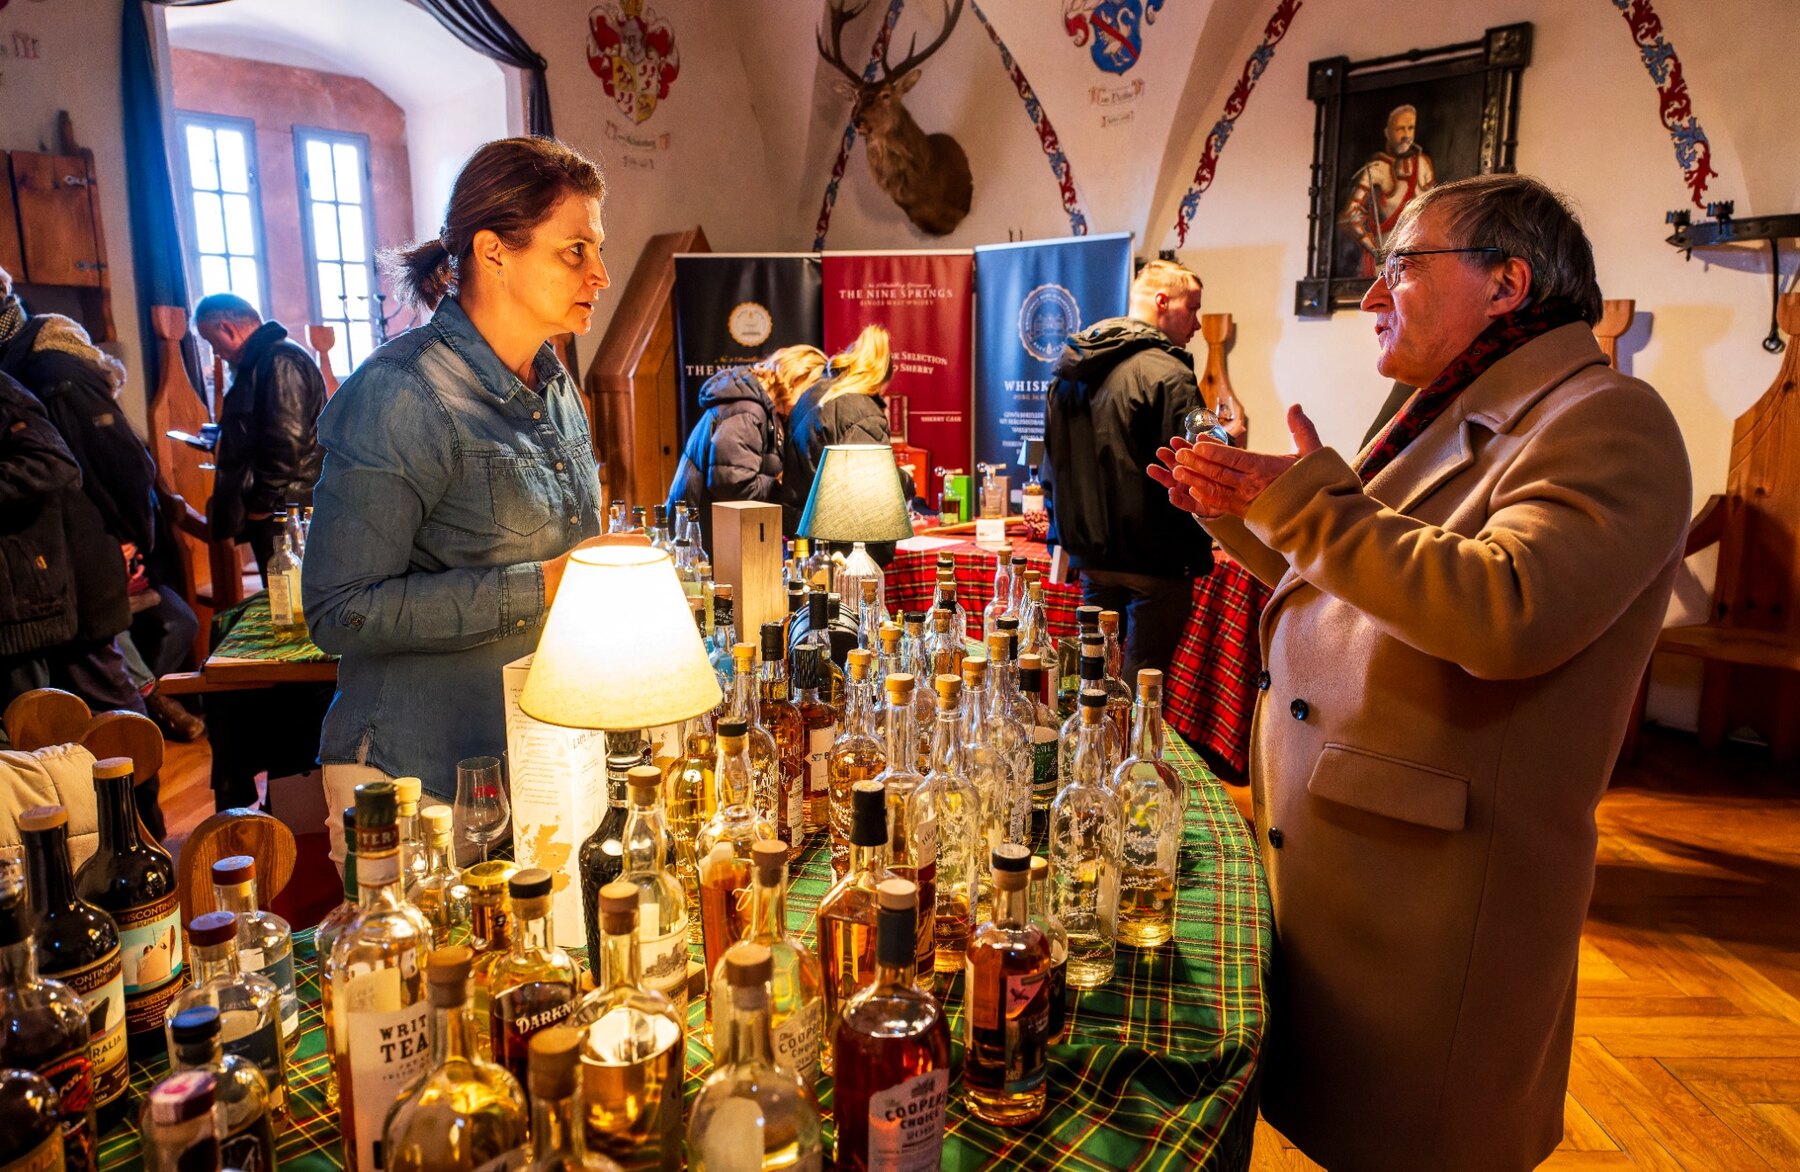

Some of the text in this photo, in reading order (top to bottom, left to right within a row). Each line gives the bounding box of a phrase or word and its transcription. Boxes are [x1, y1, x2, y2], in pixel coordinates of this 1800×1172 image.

[839, 289, 953, 299] THE NINE SPRINGS
[685, 365, 715, 377] THE
[1004, 380, 1049, 392] WHISK
[379, 1014, 427, 1041] WRIT
[516, 1000, 575, 1035] DARKN
[92, 1035, 122, 1059] RALIA
[380, 1032, 429, 1064] TEA
